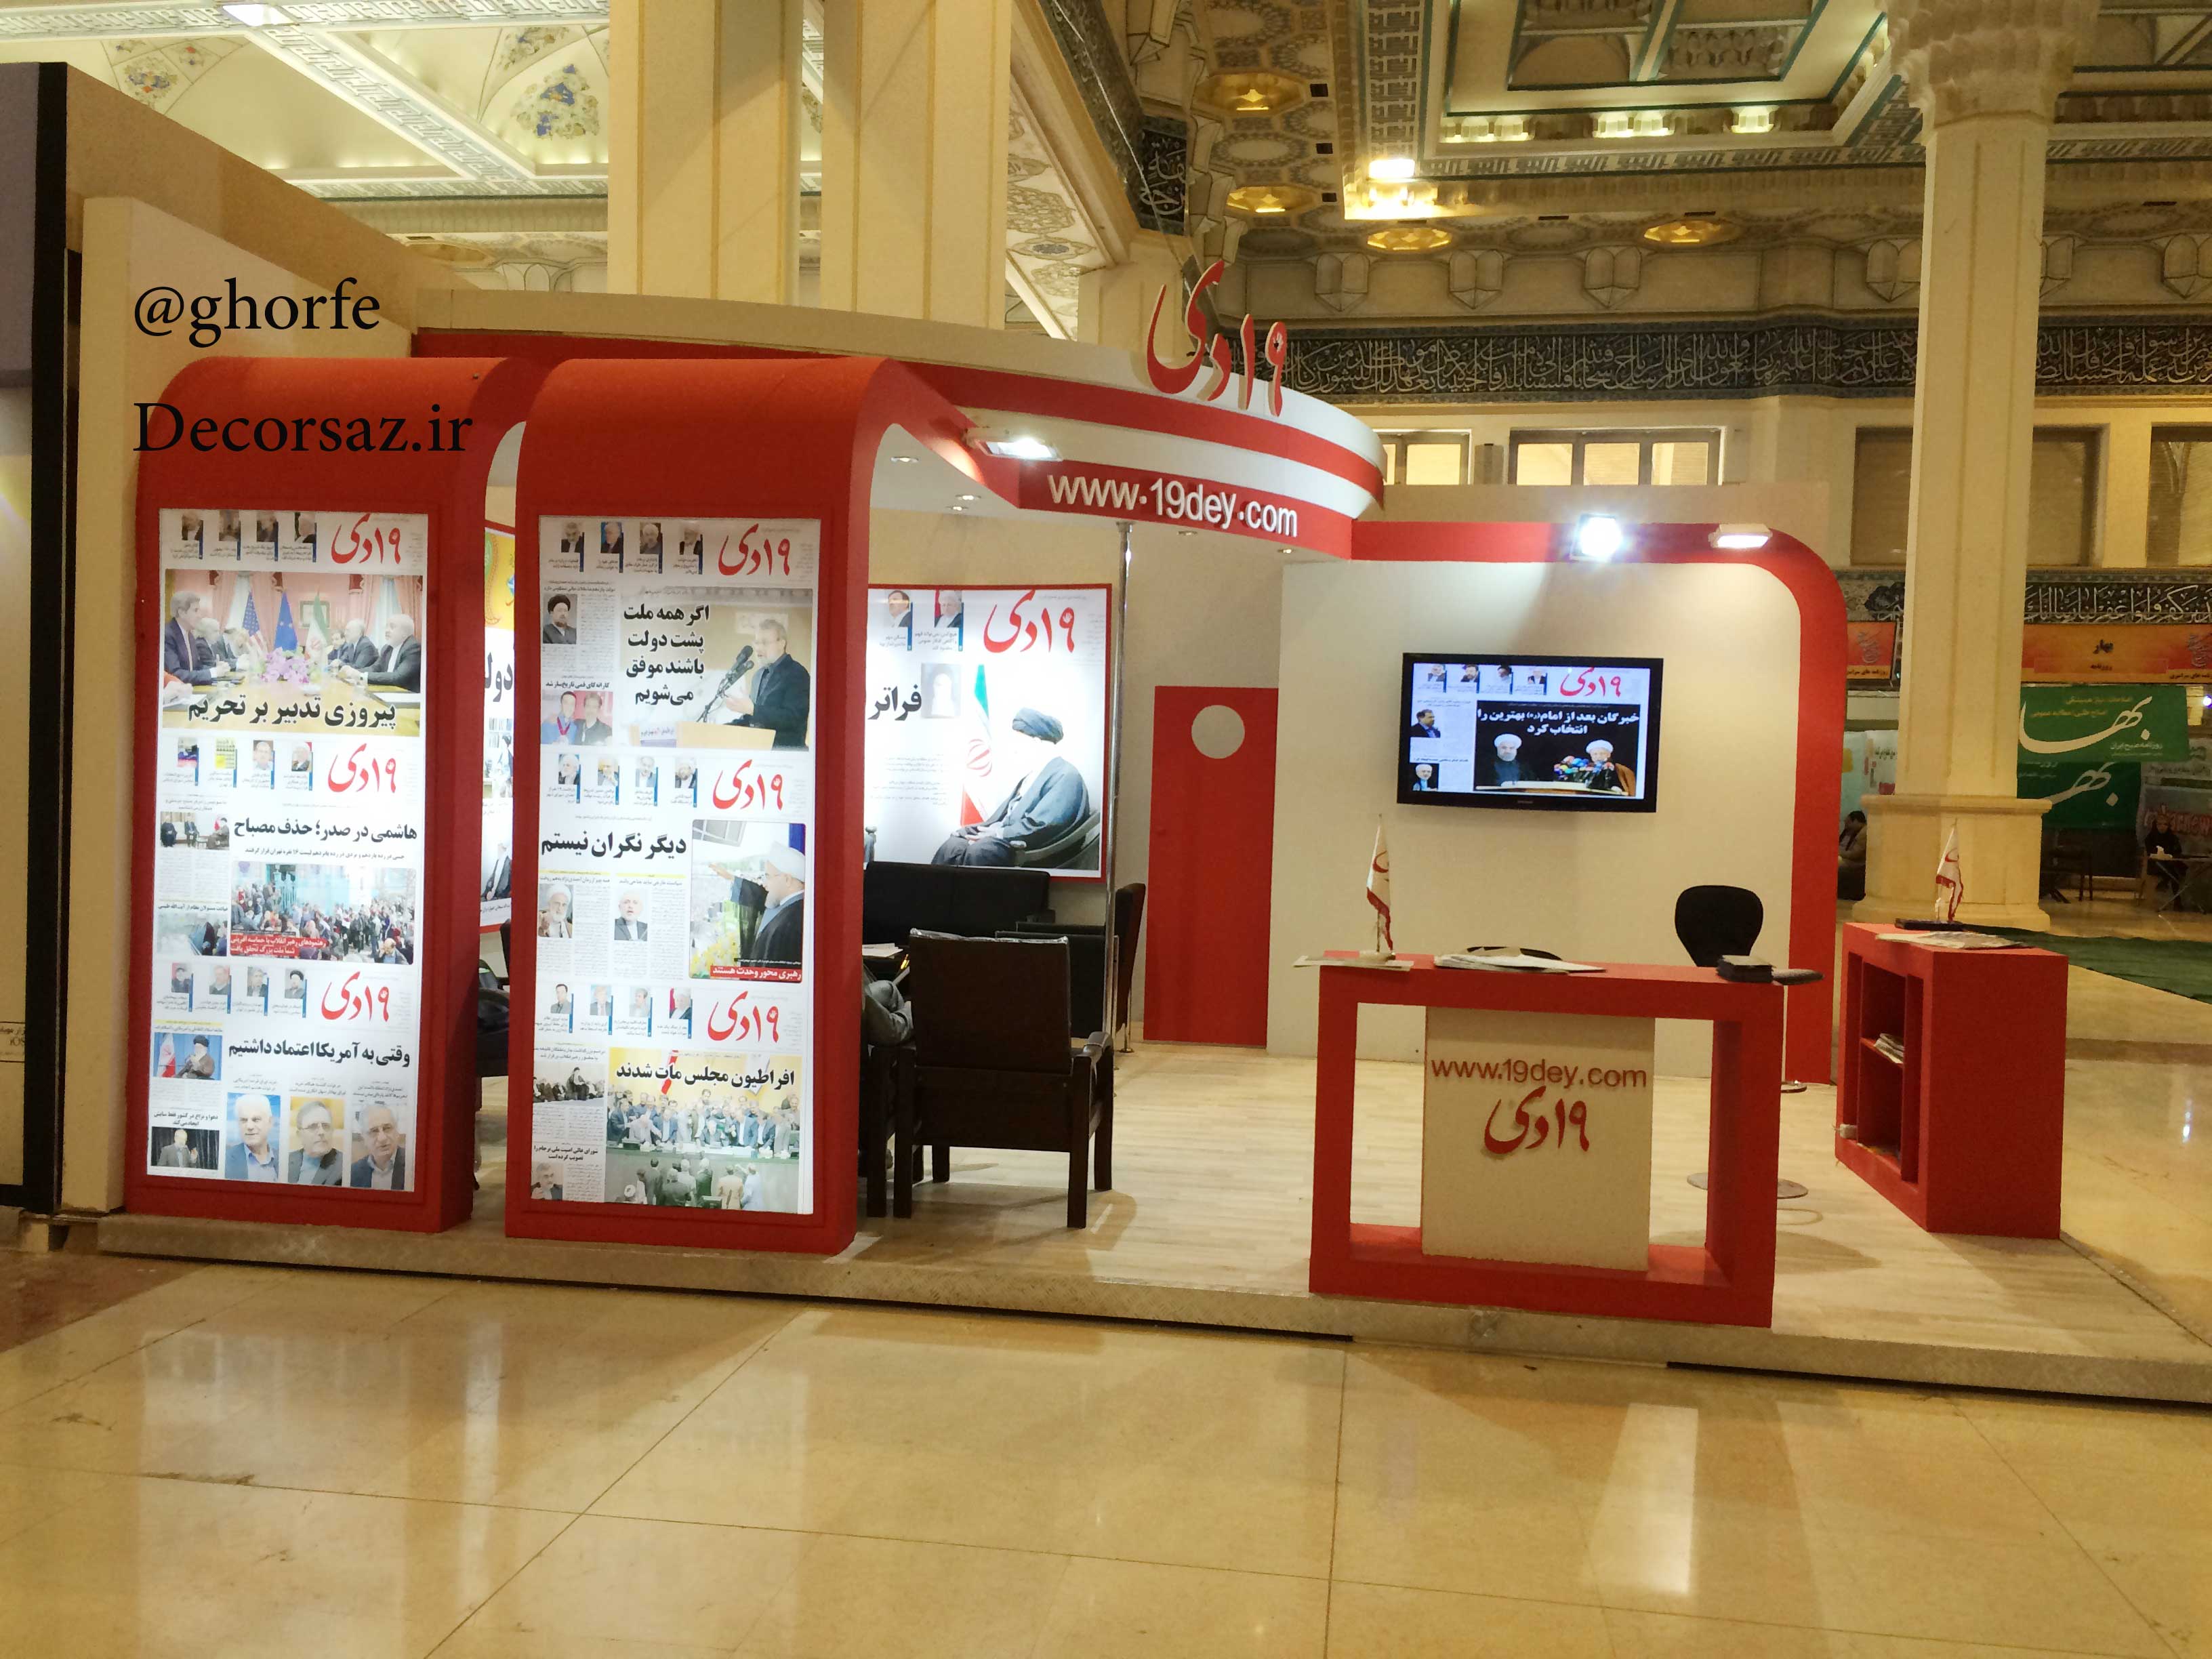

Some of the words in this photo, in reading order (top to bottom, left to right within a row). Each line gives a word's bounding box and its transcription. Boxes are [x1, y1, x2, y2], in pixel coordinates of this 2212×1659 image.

[1047, 474, 1298, 537] www.19dey.com
[623, 603, 653, 620] ملت
[657, 607, 684, 619] همه
[688, 604, 710, 626] اگر
[628, 630, 667, 652] دولت
[671, 630, 704, 653] پشت
[626, 656, 663, 678] موفق
[665, 657, 704, 676] باشند
[188, 694, 246, 722] تحریم
[249, 700, 268, 724] بر
[272, 697, 321, 724] تدبیر
[867, 684, 922, 721] فراتر
[325, 702, 396, 730] پیروزی
[1526, 723, 1549, 736] کرد
[1550, 724, 1589, 735] انتخاب
[234, 816, 276, 838] مصباح
[278, 819, 313, 836] حذف
[315, 820, 351, 842] صدر؛
[353, 825, 369, 842] در
[371, 819, 418, 842] هاشمی
[541, 830, 589, 856] نیستم
[591, 831, 643, 859] نگران
[645, 833, 687, 860] دیگر
[713, 966, 736, 975] هستند
[736, 968, 758, 979] وحدت
[760, 969, 778, 979] محور
[779, 970, 802, 981] رهبری
[228, 1038, 272, 1058] داشتیم
[273, 1040, 314, 1057] اعتماد
[314, 1042, 361, 1065] آمریکا
[361, 1048, 375, 1065] به
[375, 1046, 411, 1068] وقتی
[616, 1063, 653, 1079] شدند
[655, 1063, 682, 1081] مات
[684, 1066, 729, 1086] مجلس
[731, 1067, 795, 1092] افراطیون
[1431, 1059, 1647, 1088] www.19dey.com
